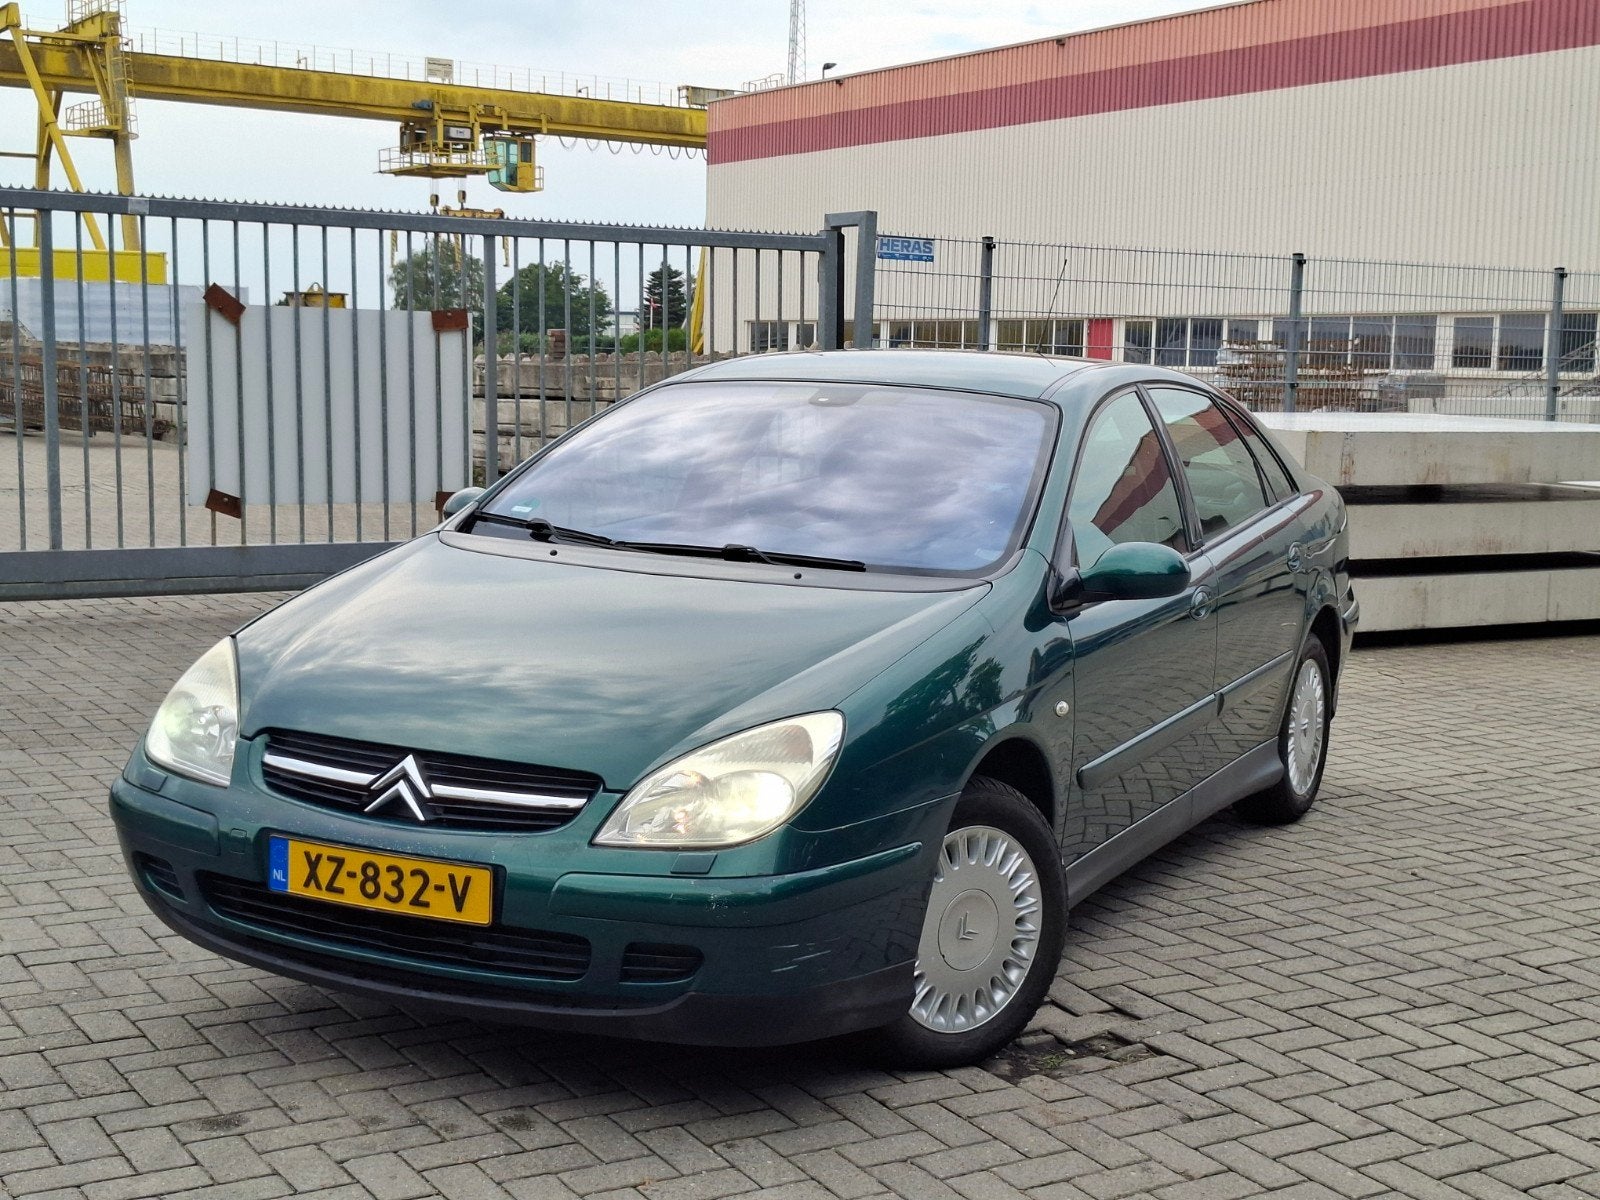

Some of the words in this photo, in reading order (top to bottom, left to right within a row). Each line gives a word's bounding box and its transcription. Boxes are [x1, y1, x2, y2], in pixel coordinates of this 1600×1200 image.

[880, 238, 933, 254] HERAS
[273, 868, 286, 881] NL
[303, 851, 472, 913] XZ-832-V
